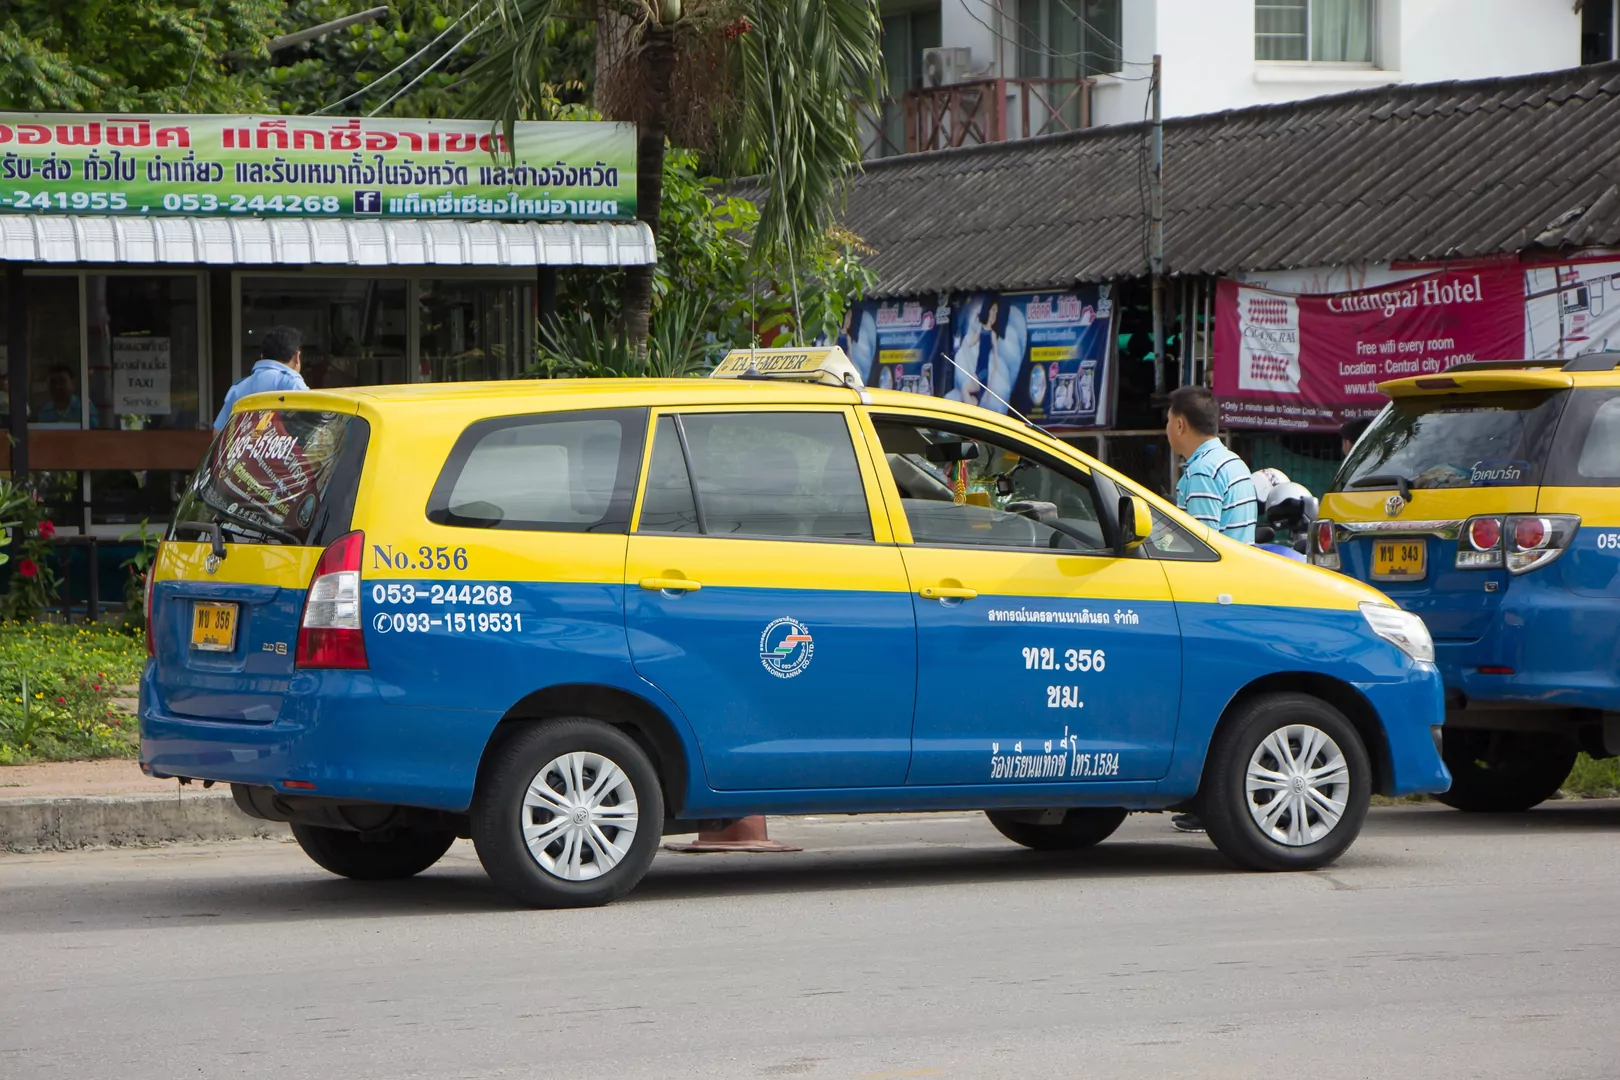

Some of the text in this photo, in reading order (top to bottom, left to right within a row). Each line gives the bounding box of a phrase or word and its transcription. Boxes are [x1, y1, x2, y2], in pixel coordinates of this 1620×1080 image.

[2, 152, 71, 180] รับ-ส่ง
[84, 148, 135, 181] ทั่วไป
[147, 150, 224, 182] นำเที่ยว
[163, 193, 340, 213] 053-244268
[389, 191, 618, 215] แท็กซี่เชียงใหม่อาเขต
[1422, 274, 1483, 306] Hotel
[1357, 338, 1454, 355] Free wifi every room
[1340, 362, 1376, 375] Location
[1385, 359, 1419, 373] Central
[1422, 358, 1440, 373] city
[127, 378, 154, 388] TAXI
[1470, 461, 1520, 484] โอเคมาร์ท
[372, 544, 468, 571] No.356
[1402, 545, 1418, 561] 343
[372, 584, 512, 605] 053-244268
[215, 610, 231, 630] 356
[394, 613, 522, 632] 093-1519531
[1113, 608, 1139, 625] จำกัด
[1022, 647, 1106, 672] ทข. 356
[1047, 685, 1084, 708] ชม.
[1070, 734, 1119, 777] โทร.1584
